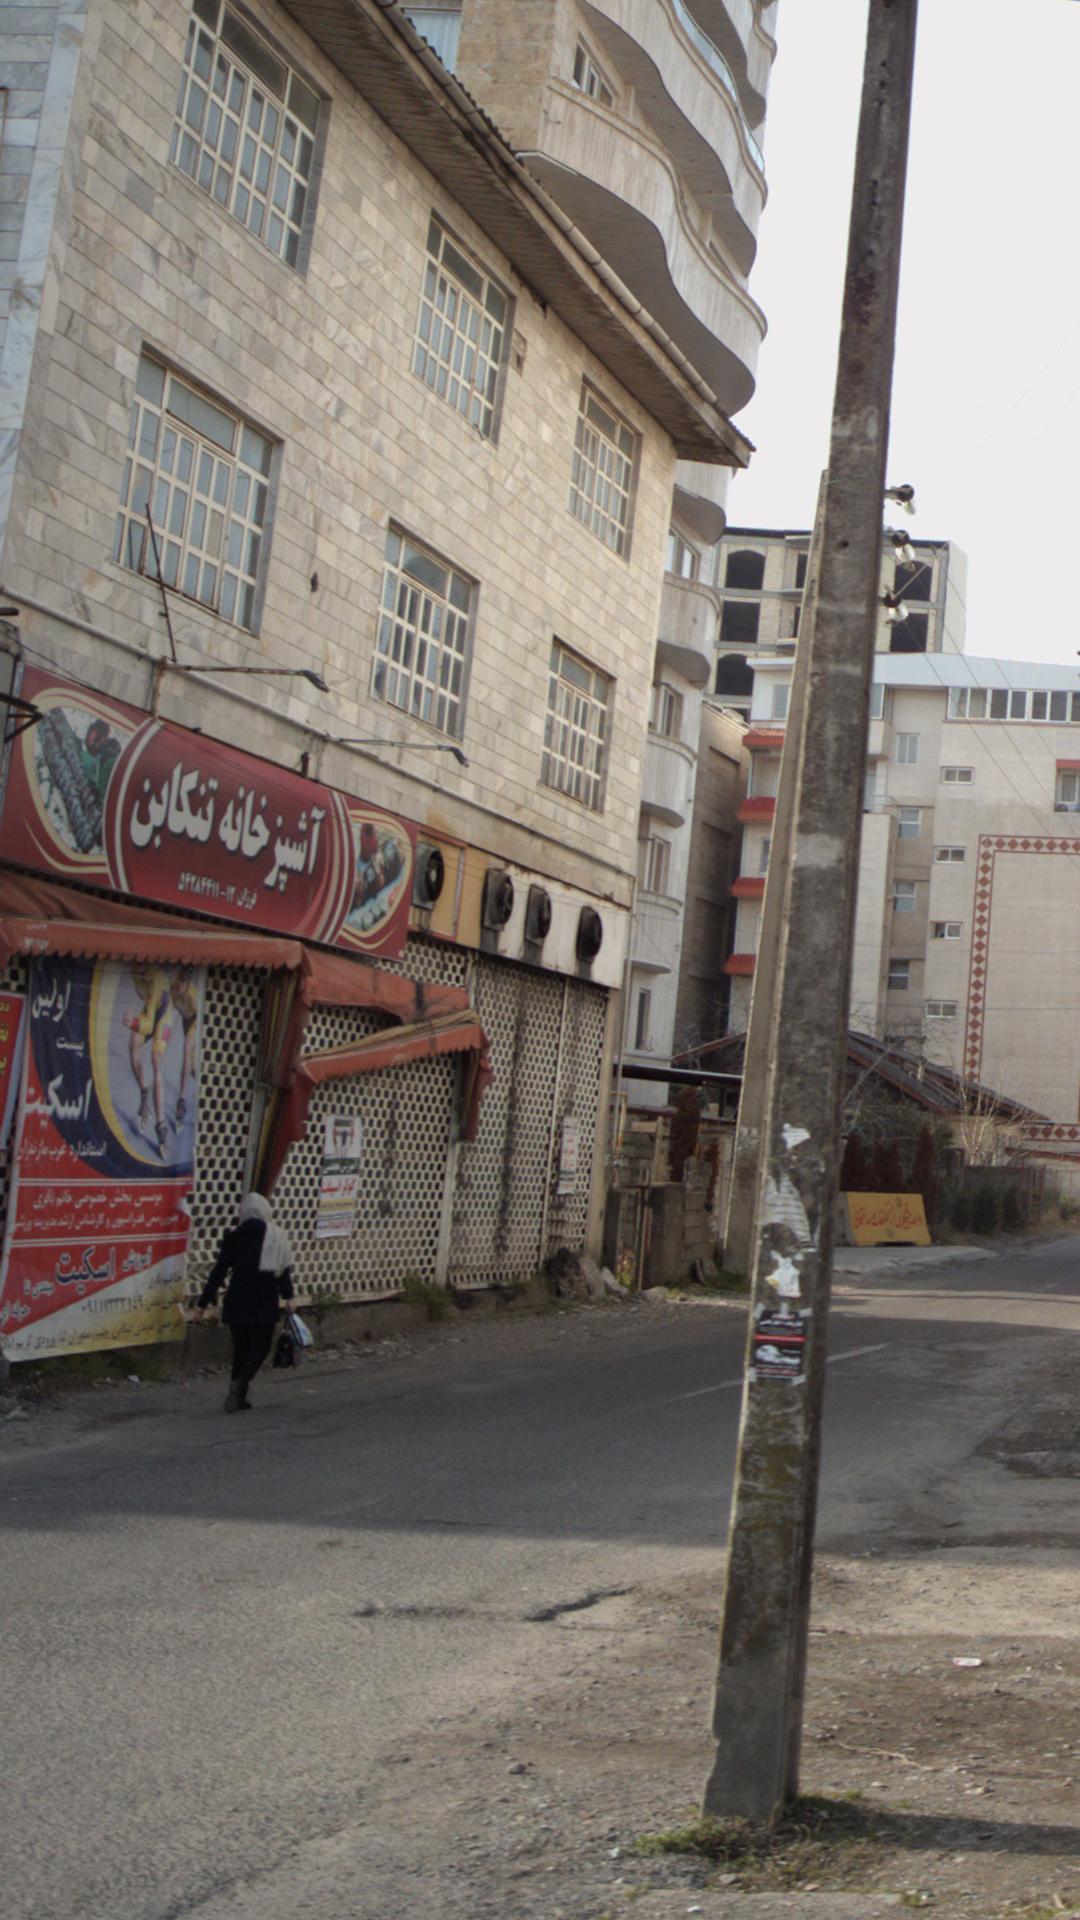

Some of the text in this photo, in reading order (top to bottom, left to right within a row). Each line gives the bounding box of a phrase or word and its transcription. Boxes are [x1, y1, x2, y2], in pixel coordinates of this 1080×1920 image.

[131, 761, 326, 893] آشپزخانه تنکابن
[32, 977, 71, 1022] اولین
[55, 1244, 117, 1296] اسکیت
